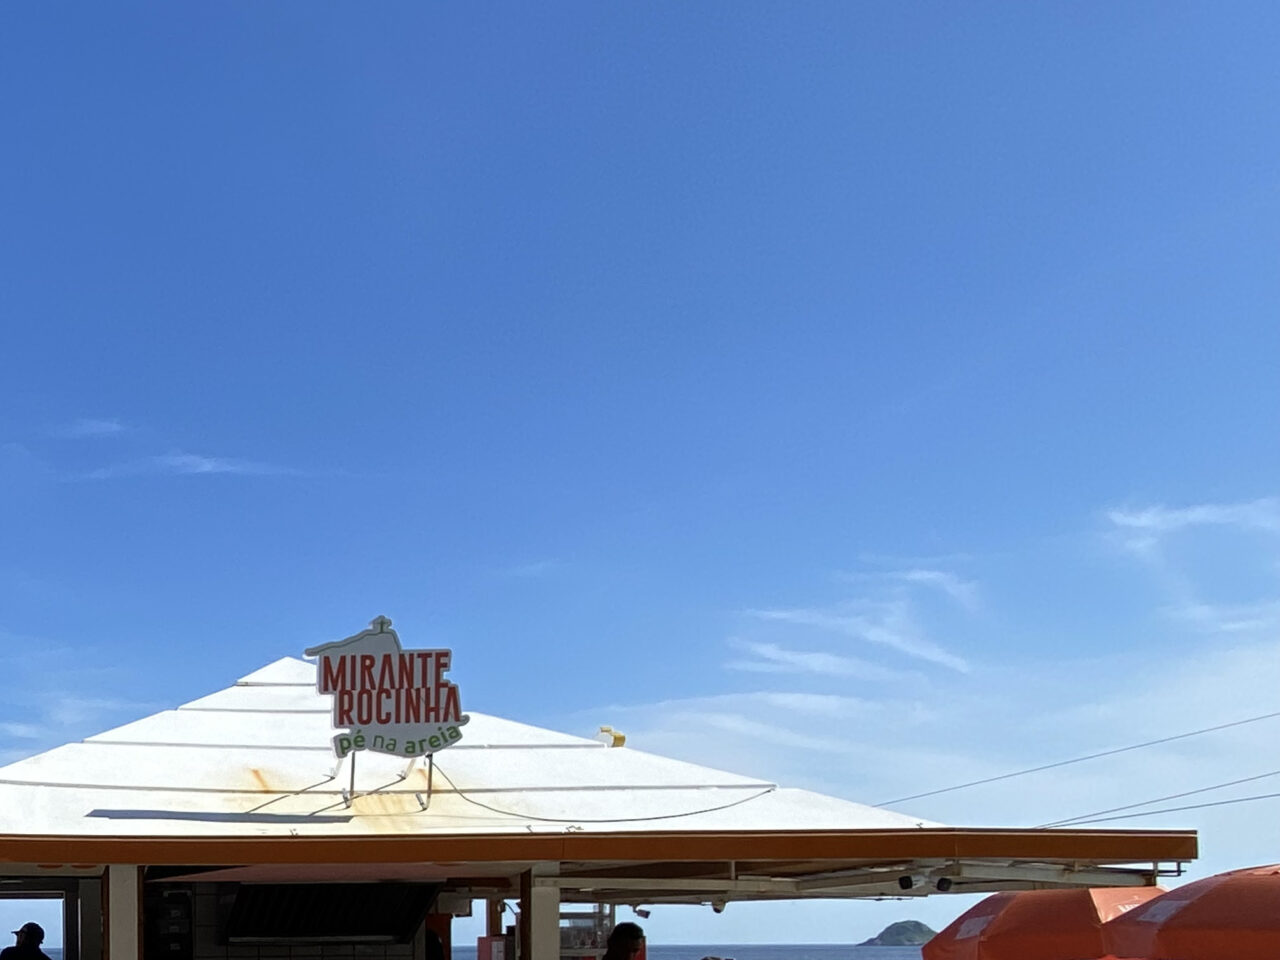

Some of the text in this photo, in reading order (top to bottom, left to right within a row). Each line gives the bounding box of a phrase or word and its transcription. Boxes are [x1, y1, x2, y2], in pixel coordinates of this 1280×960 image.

[323, 652, 449, 691] MIRANTE
[338, 687, 461, 725] ROCINHA
[339, 726, 461, 755] pé na areia
